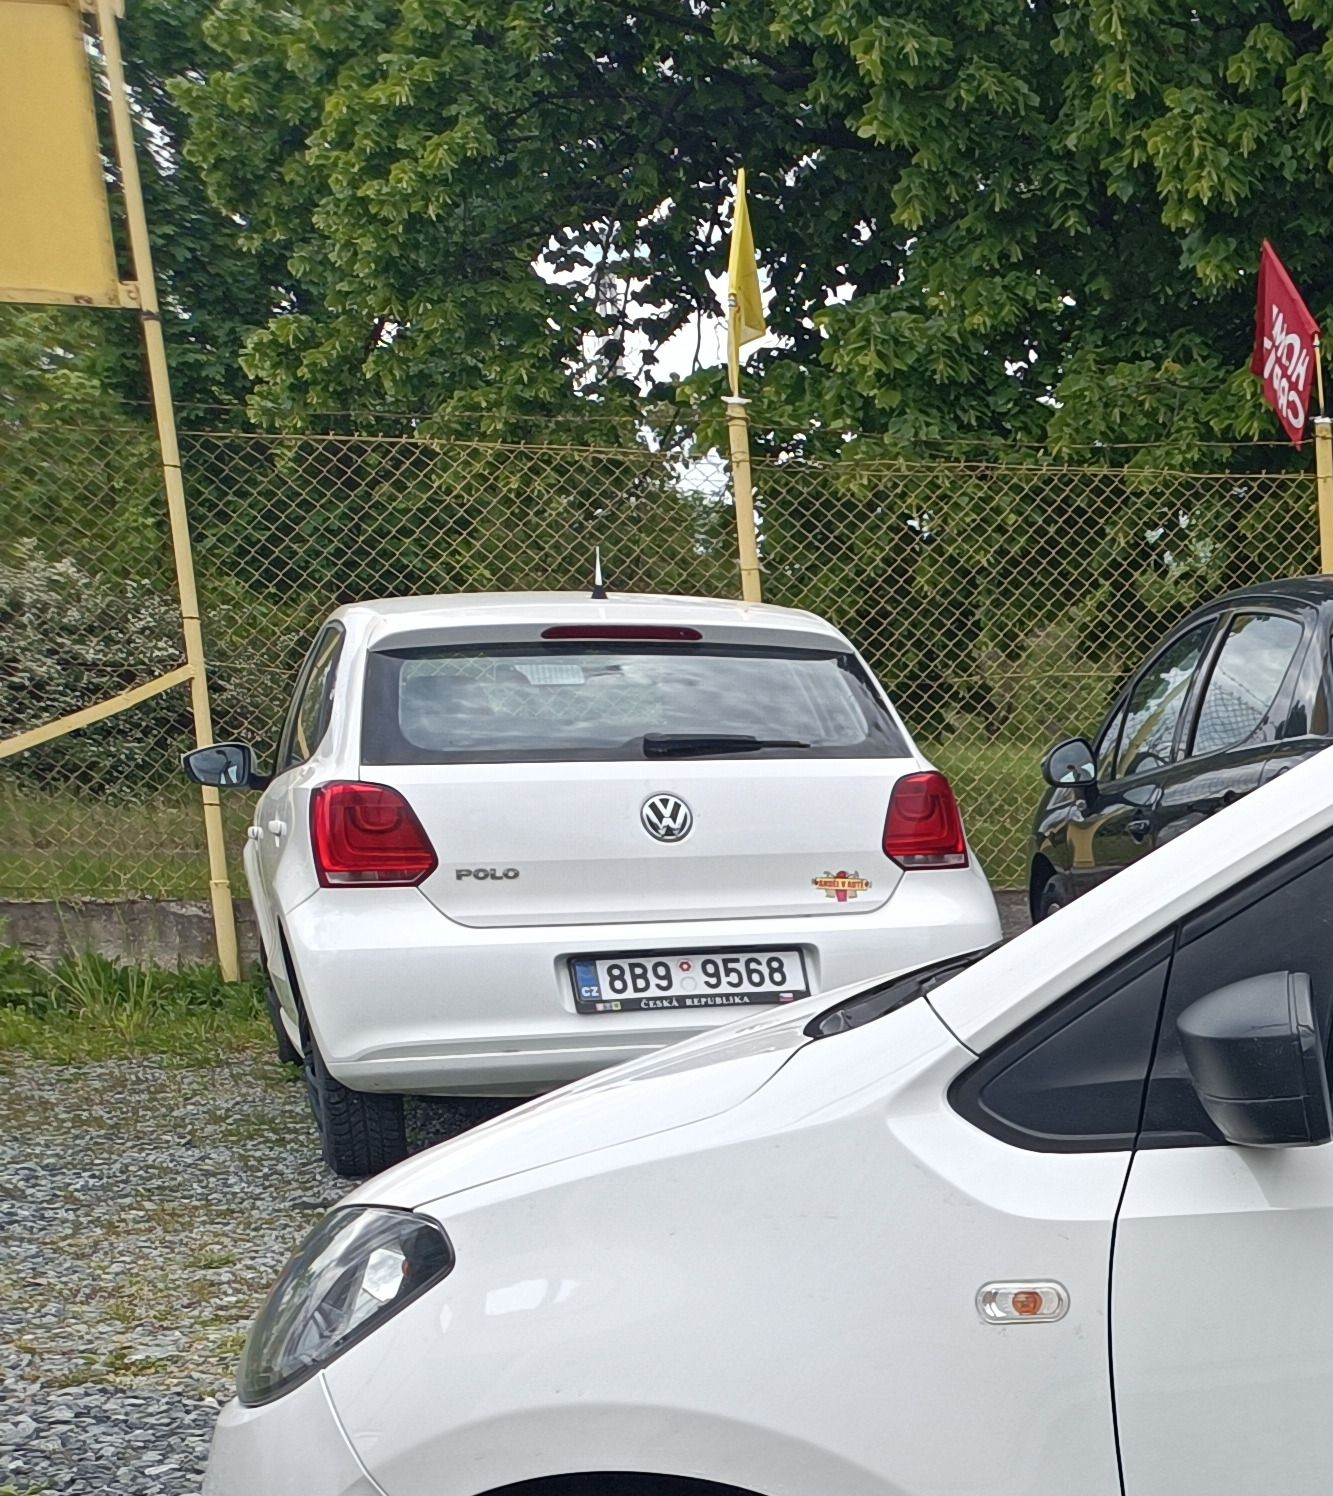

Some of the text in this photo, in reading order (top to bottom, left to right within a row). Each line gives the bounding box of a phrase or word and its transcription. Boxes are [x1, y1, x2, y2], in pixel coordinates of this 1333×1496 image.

[455, 867, 520, 881] POLO
[606, 956, 787, 994] 8B9 9568
[581, 986, 599, 997] CZ
[640, 995, 750, 1009] ČESKÁ REPUBLIKA
